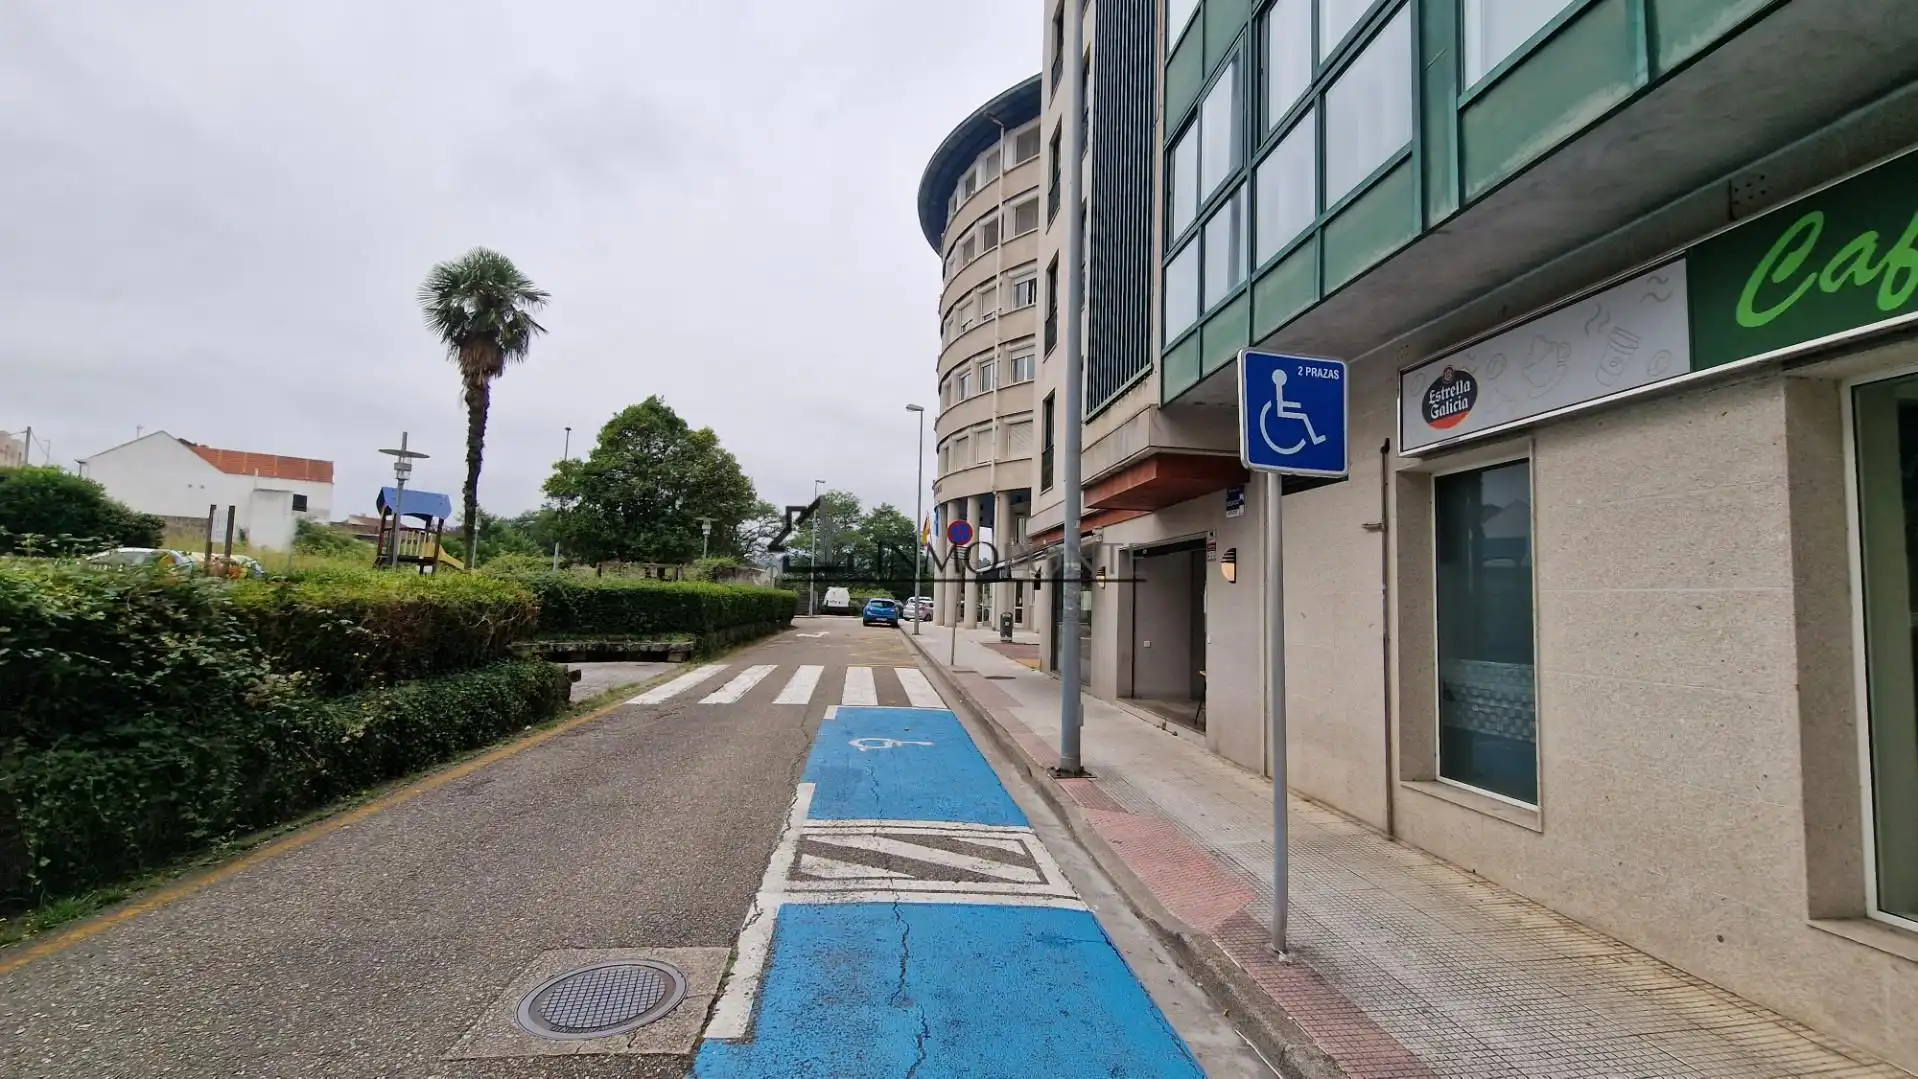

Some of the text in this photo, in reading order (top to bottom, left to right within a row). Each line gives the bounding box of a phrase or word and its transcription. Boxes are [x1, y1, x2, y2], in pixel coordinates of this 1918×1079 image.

[1297, 366, 1340, 380] 2 PRAZAS
[1429, 380, 1470, 404] Estrella
[1430, 395, 1469, 419] Galicia
